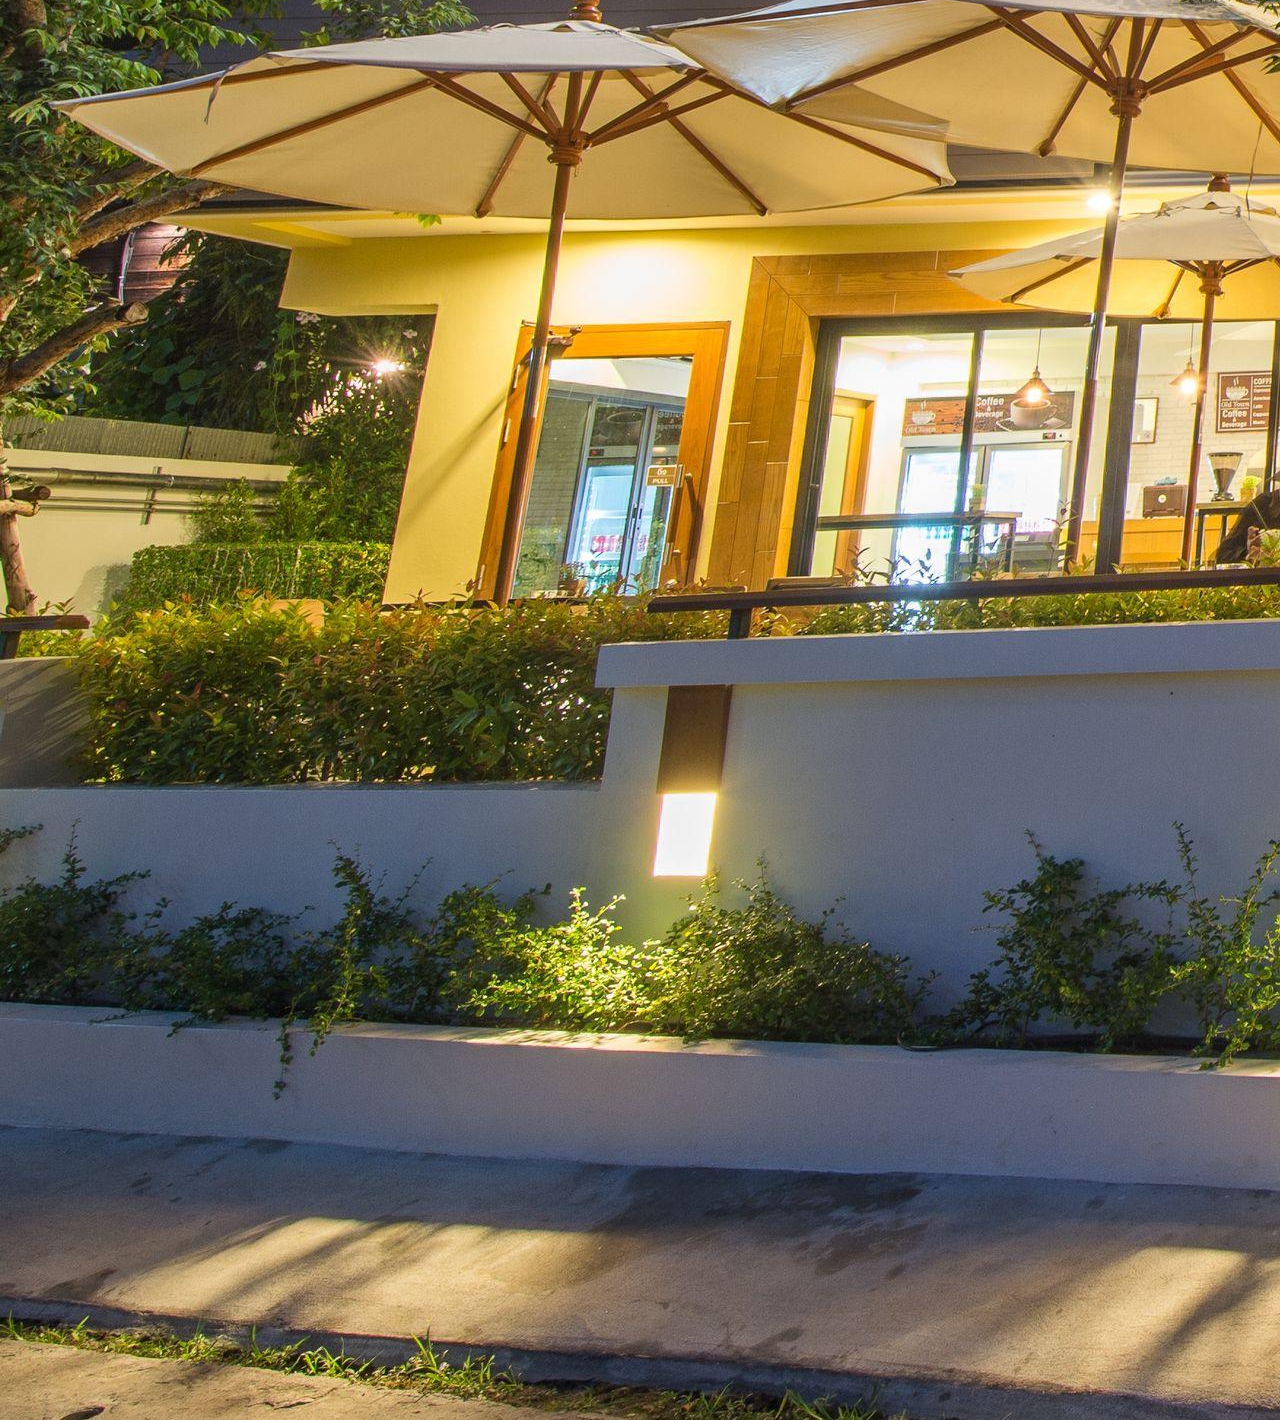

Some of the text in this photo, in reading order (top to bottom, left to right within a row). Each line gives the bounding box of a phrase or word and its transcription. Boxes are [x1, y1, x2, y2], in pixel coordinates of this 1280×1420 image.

[1253, 377, 1272, 385] COFF
[975, 396, 1005, 408] Coffee
[1222, 409, 1248, 418] Coffee
[652, 477, 669, 485] PULL
